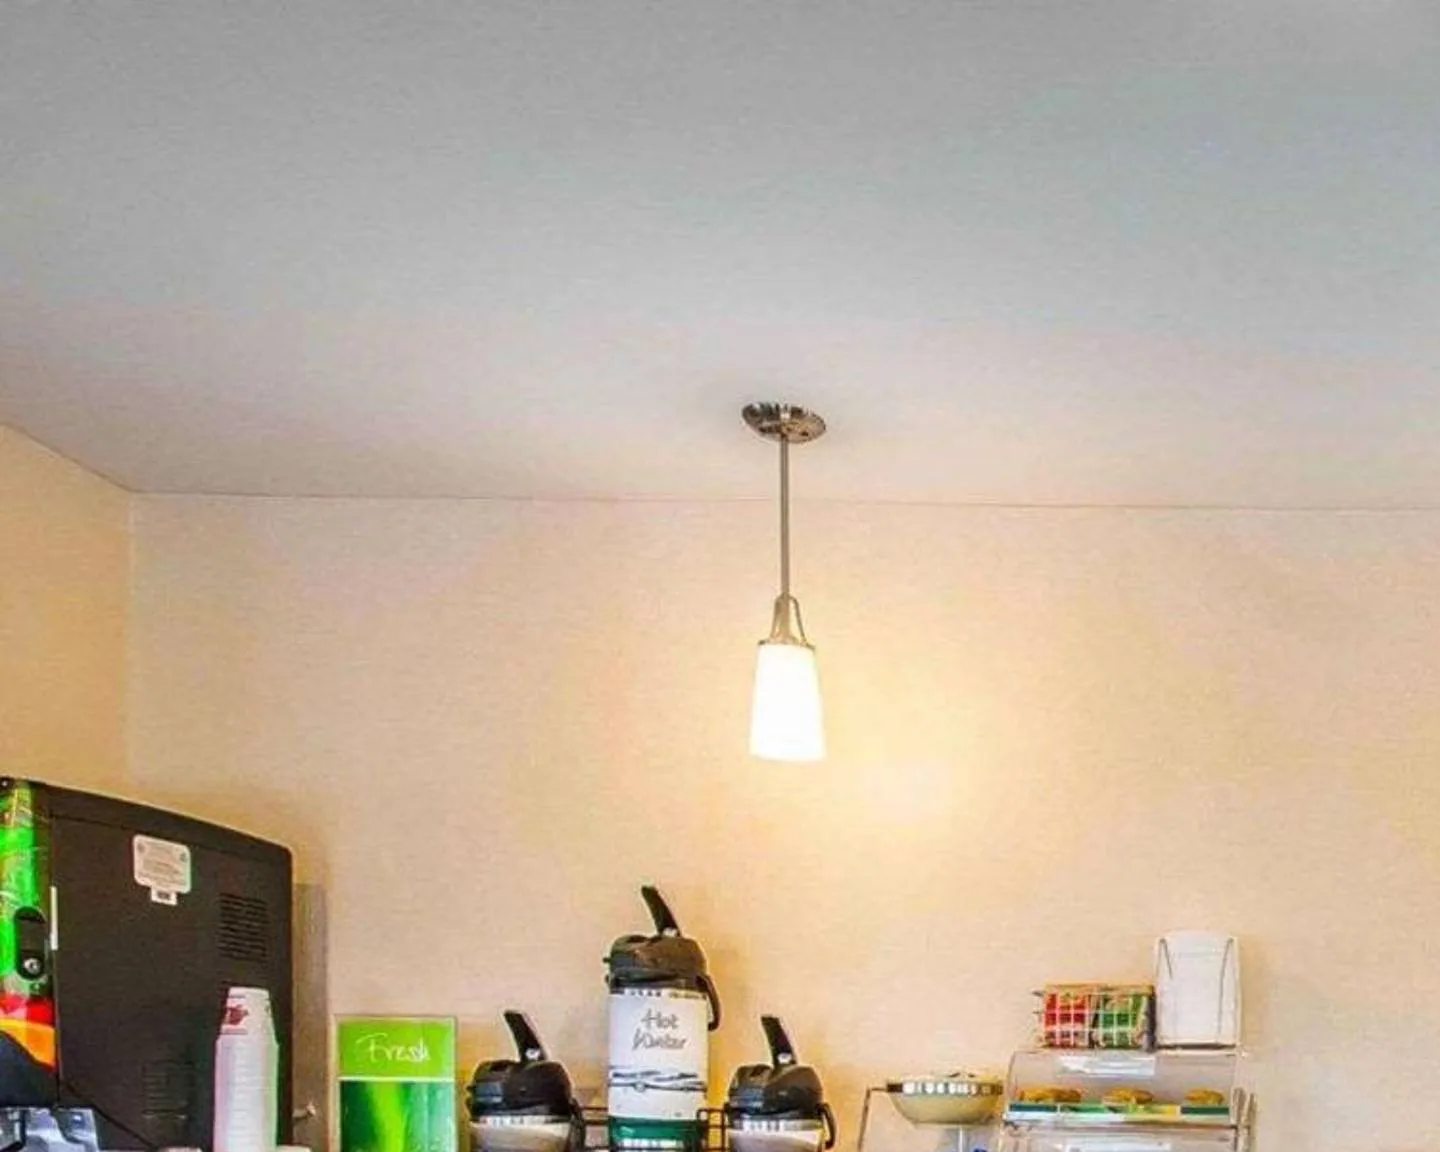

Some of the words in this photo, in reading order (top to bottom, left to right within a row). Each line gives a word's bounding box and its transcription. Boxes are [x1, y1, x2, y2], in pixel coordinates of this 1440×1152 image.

[641, 1008, 679, 1030] Hot
[355, 1032, 432, 1063] Fresh
[632, 1027, 687, 1051] Water
